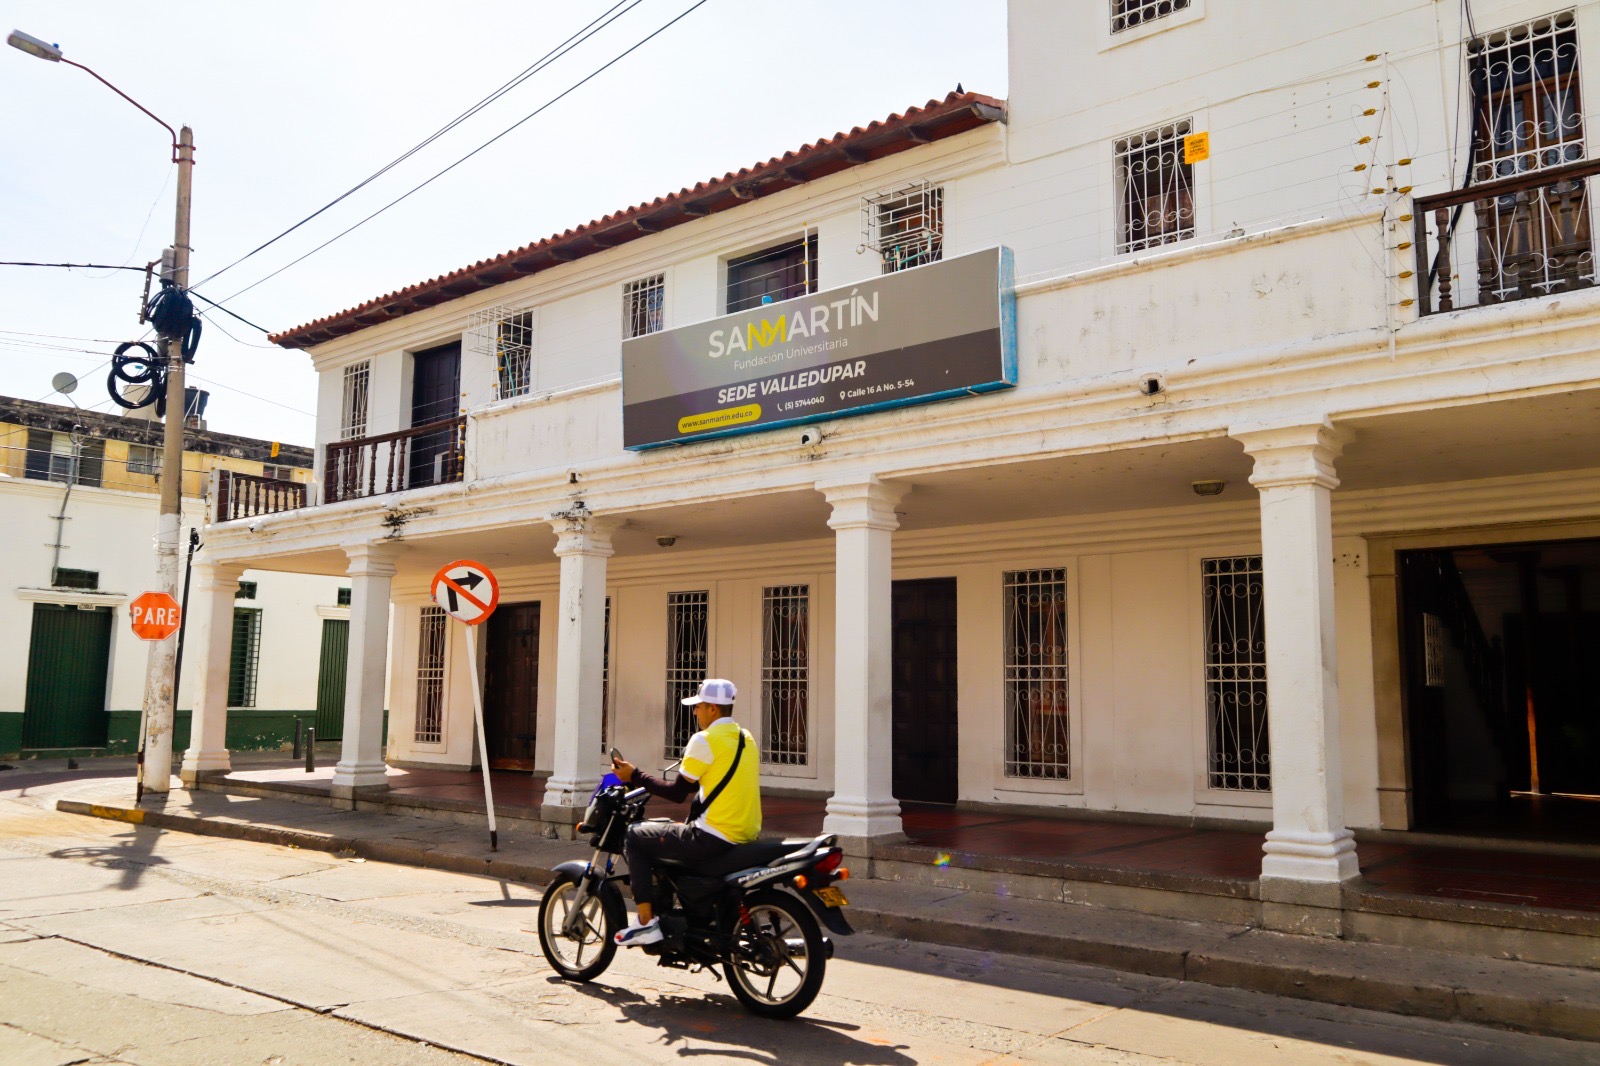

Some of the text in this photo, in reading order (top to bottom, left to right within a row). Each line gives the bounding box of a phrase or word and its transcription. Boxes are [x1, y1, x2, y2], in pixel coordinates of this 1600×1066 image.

[708, 288, 879, 358] SANMARTÍN
[734, 337, 848, 371] Fundación Universitaria
[717, 360, 867, 404] SEDE VALLEDUPAR
[847, 389, 866, 398] Calle
[876, 384, 882, 392] A
[883, 382, 896, 391] No.
[897, 379, 915, 389] 5-54
[784, 395, 825, 410] (5) 5744040
[682, 410, 753, 429] www.sanmartin.edu.co
[132, 606, 177, 626] PARE
